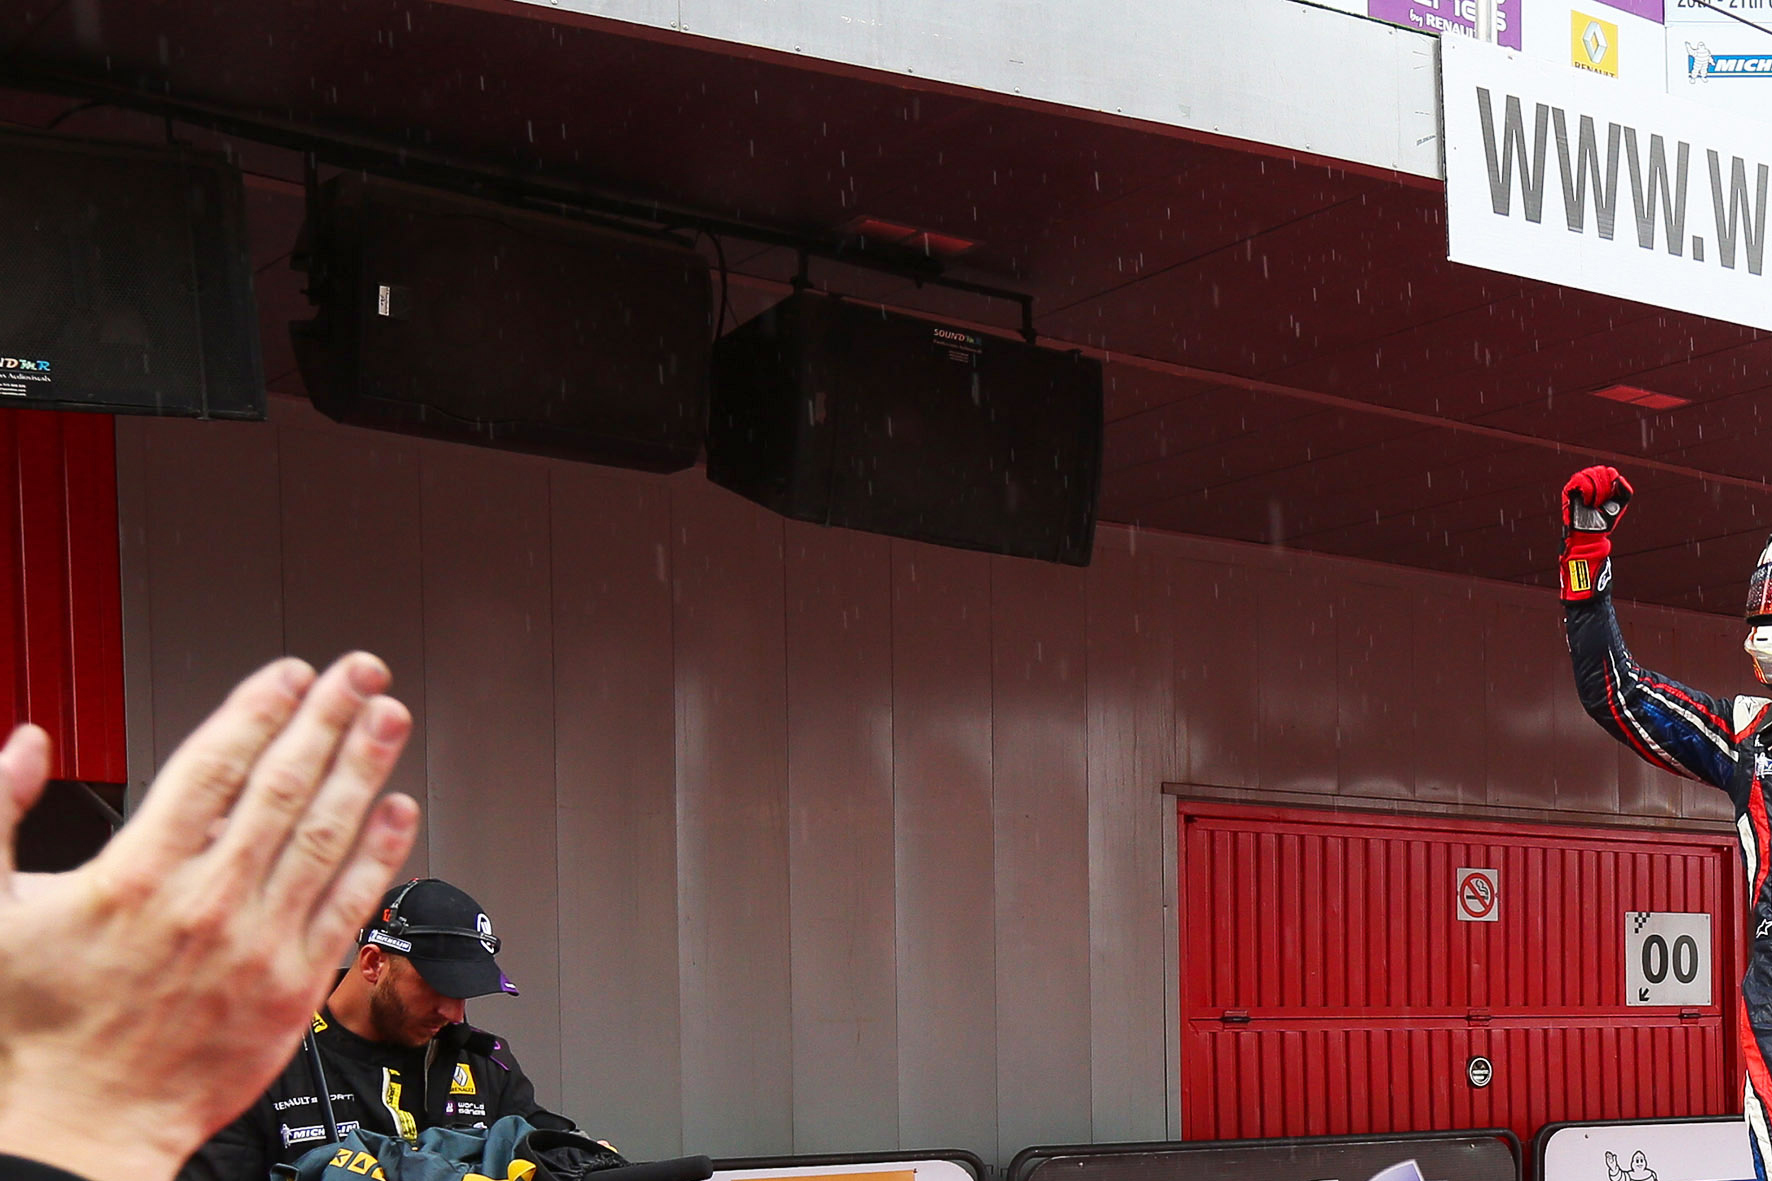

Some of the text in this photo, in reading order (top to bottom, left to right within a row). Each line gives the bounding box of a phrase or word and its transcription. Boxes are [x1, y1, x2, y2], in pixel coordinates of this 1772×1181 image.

[1409, 8, 1423, 27] by
[933, 328, 966, 342] SOUND
[1641, 934, 1700, 985] 00
